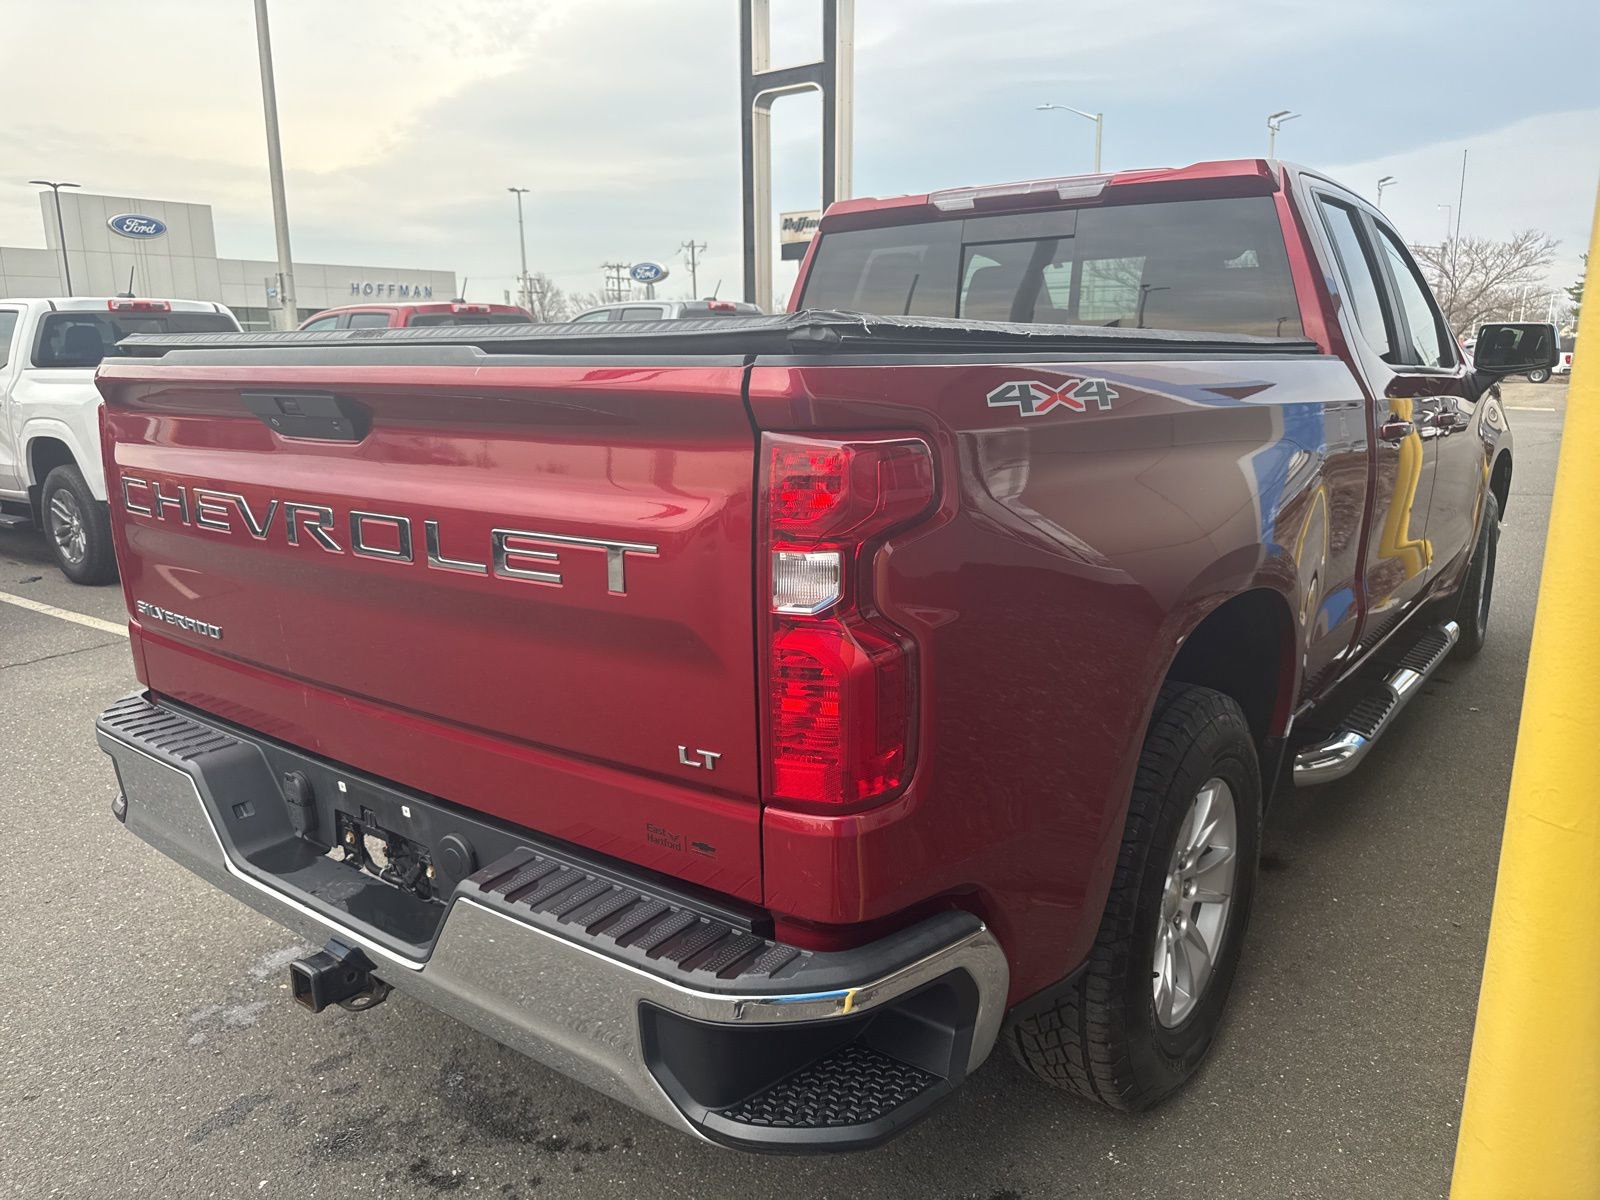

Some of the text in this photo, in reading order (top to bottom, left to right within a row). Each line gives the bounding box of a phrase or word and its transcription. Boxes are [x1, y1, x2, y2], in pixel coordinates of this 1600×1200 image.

[123, 218, 156, 234] Ford
[634, 266, 657, 279] Ford
[350, 283, 433, 298] HOFFMAN
[121, 476, 660, 596] CHEVROLET
[136, 600, 222, 640] SILVERADO
[678, 745, 721, 770] LT
[646, 823, 666, 836] East
[647, 833, 681, 851] Hartford
